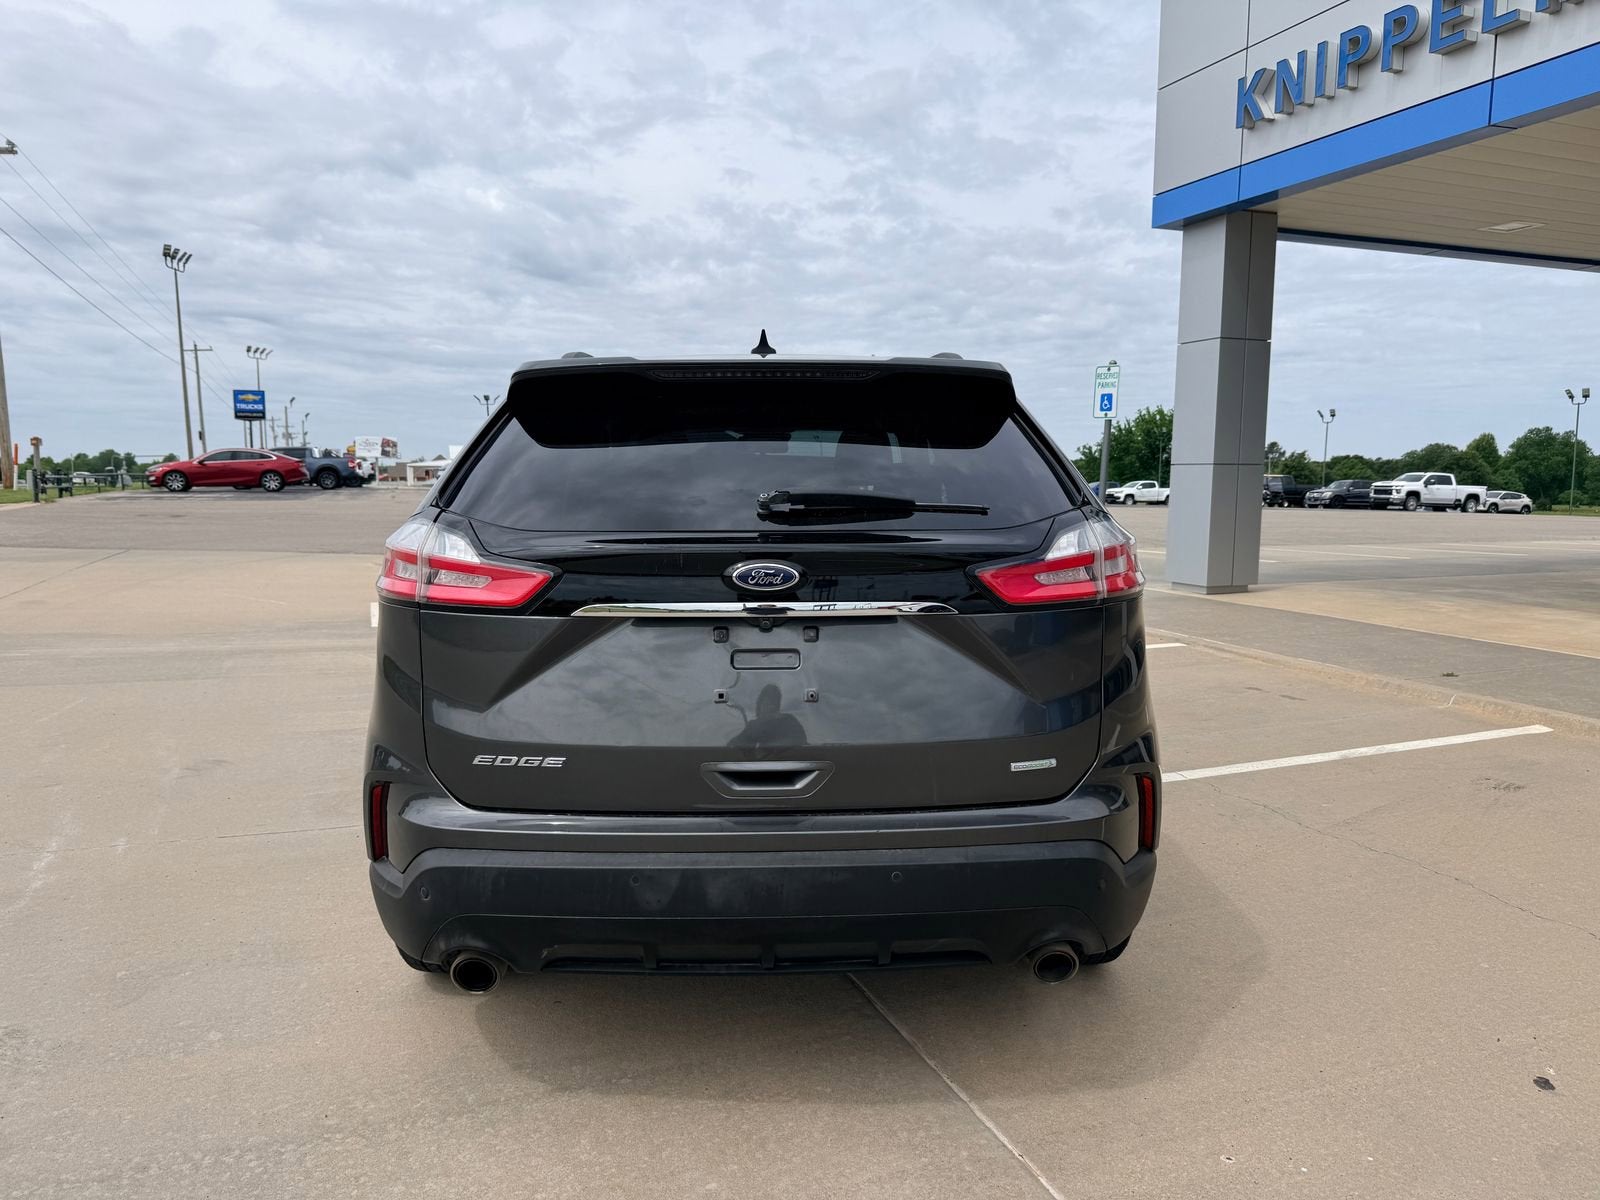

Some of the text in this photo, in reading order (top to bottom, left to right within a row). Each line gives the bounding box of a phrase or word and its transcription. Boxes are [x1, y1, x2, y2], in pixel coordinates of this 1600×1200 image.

[1236, 0, 1568, 128] KNIPPEL
[1096, 372, 1119, 380] RESERVED
[1097, 381, 1117, 389] PARKING
[748, 569, 784, 584] Ford
[472, 754, 567, 767] EDGE
